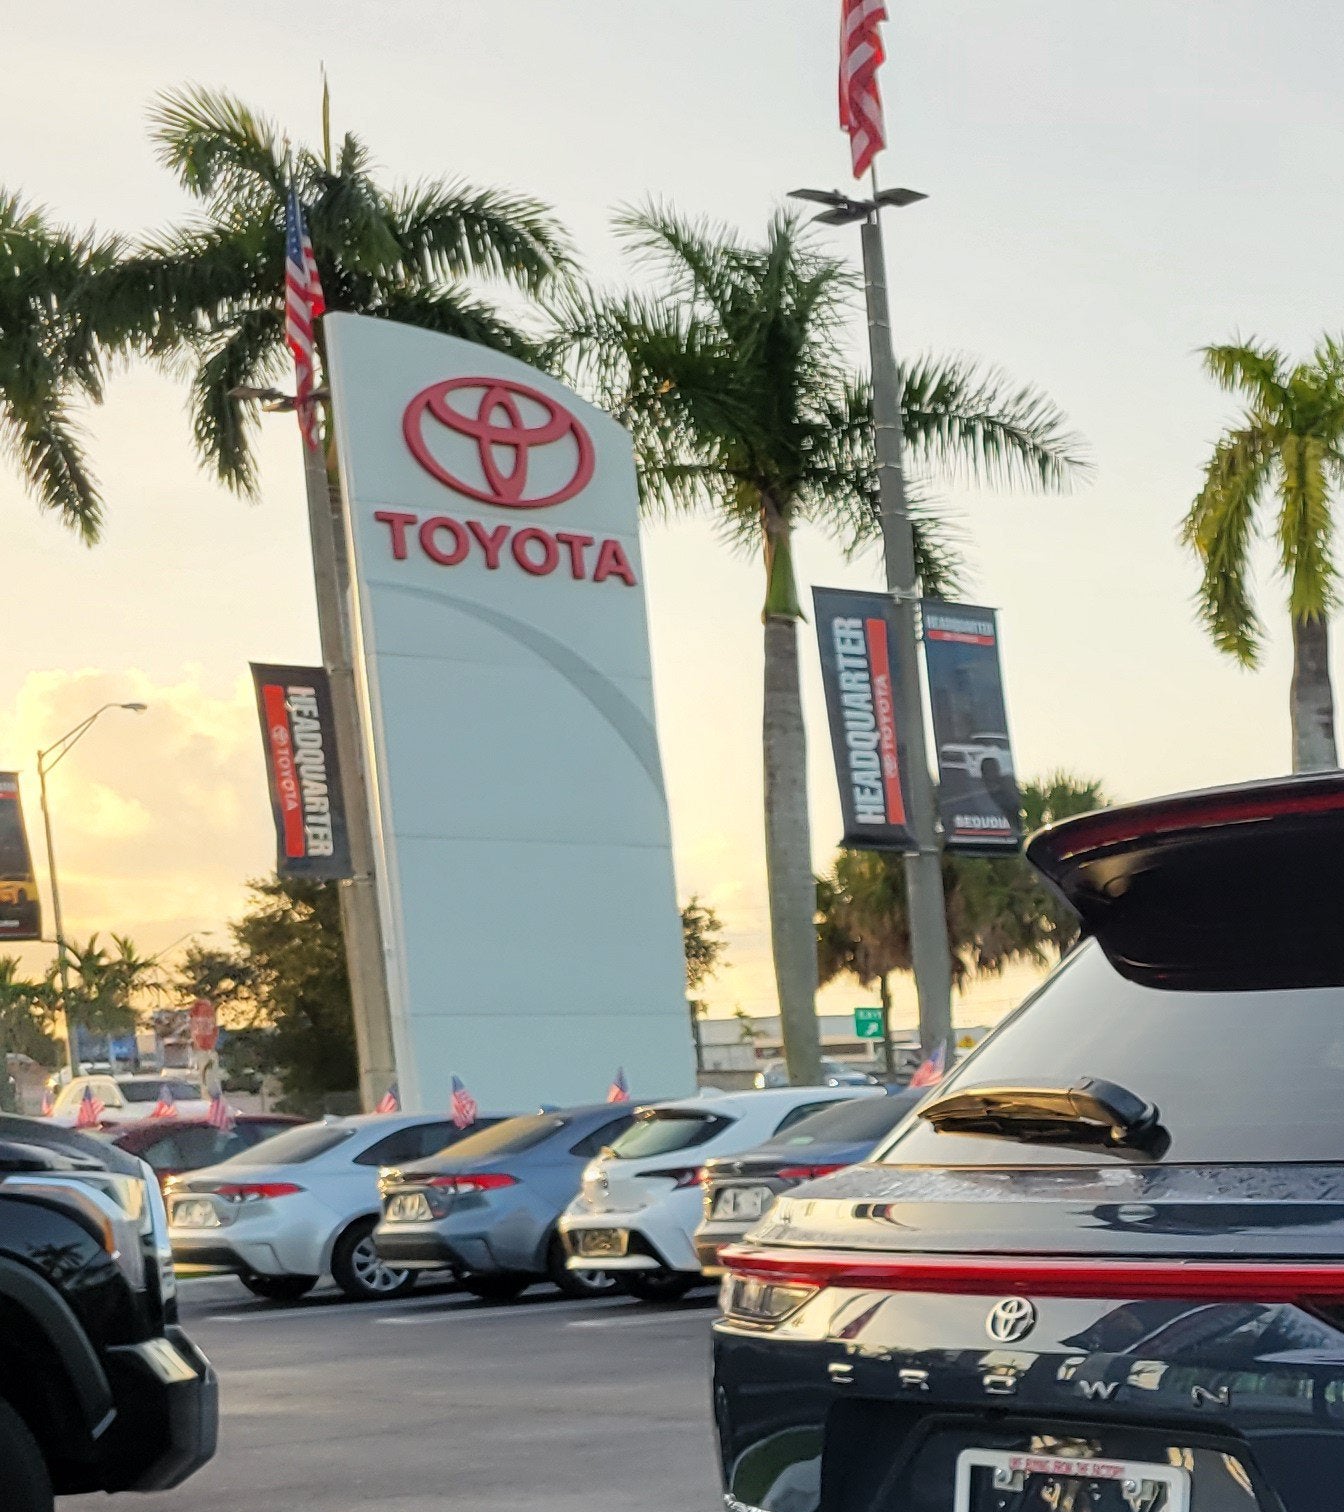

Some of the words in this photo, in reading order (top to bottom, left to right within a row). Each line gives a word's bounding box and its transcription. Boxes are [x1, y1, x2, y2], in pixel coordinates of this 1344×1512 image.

[374, 511, 639, 587] TOYOTA
[832, 616, 885, 824] HEADQUARTER
[874, 674, 898, 752] TOYOTA
[278, 748, 299, 811] TOYOTA
[287, 685, 334, 857] HEADQUARTER
[828, 1362, 1230, 1408] CROWN
